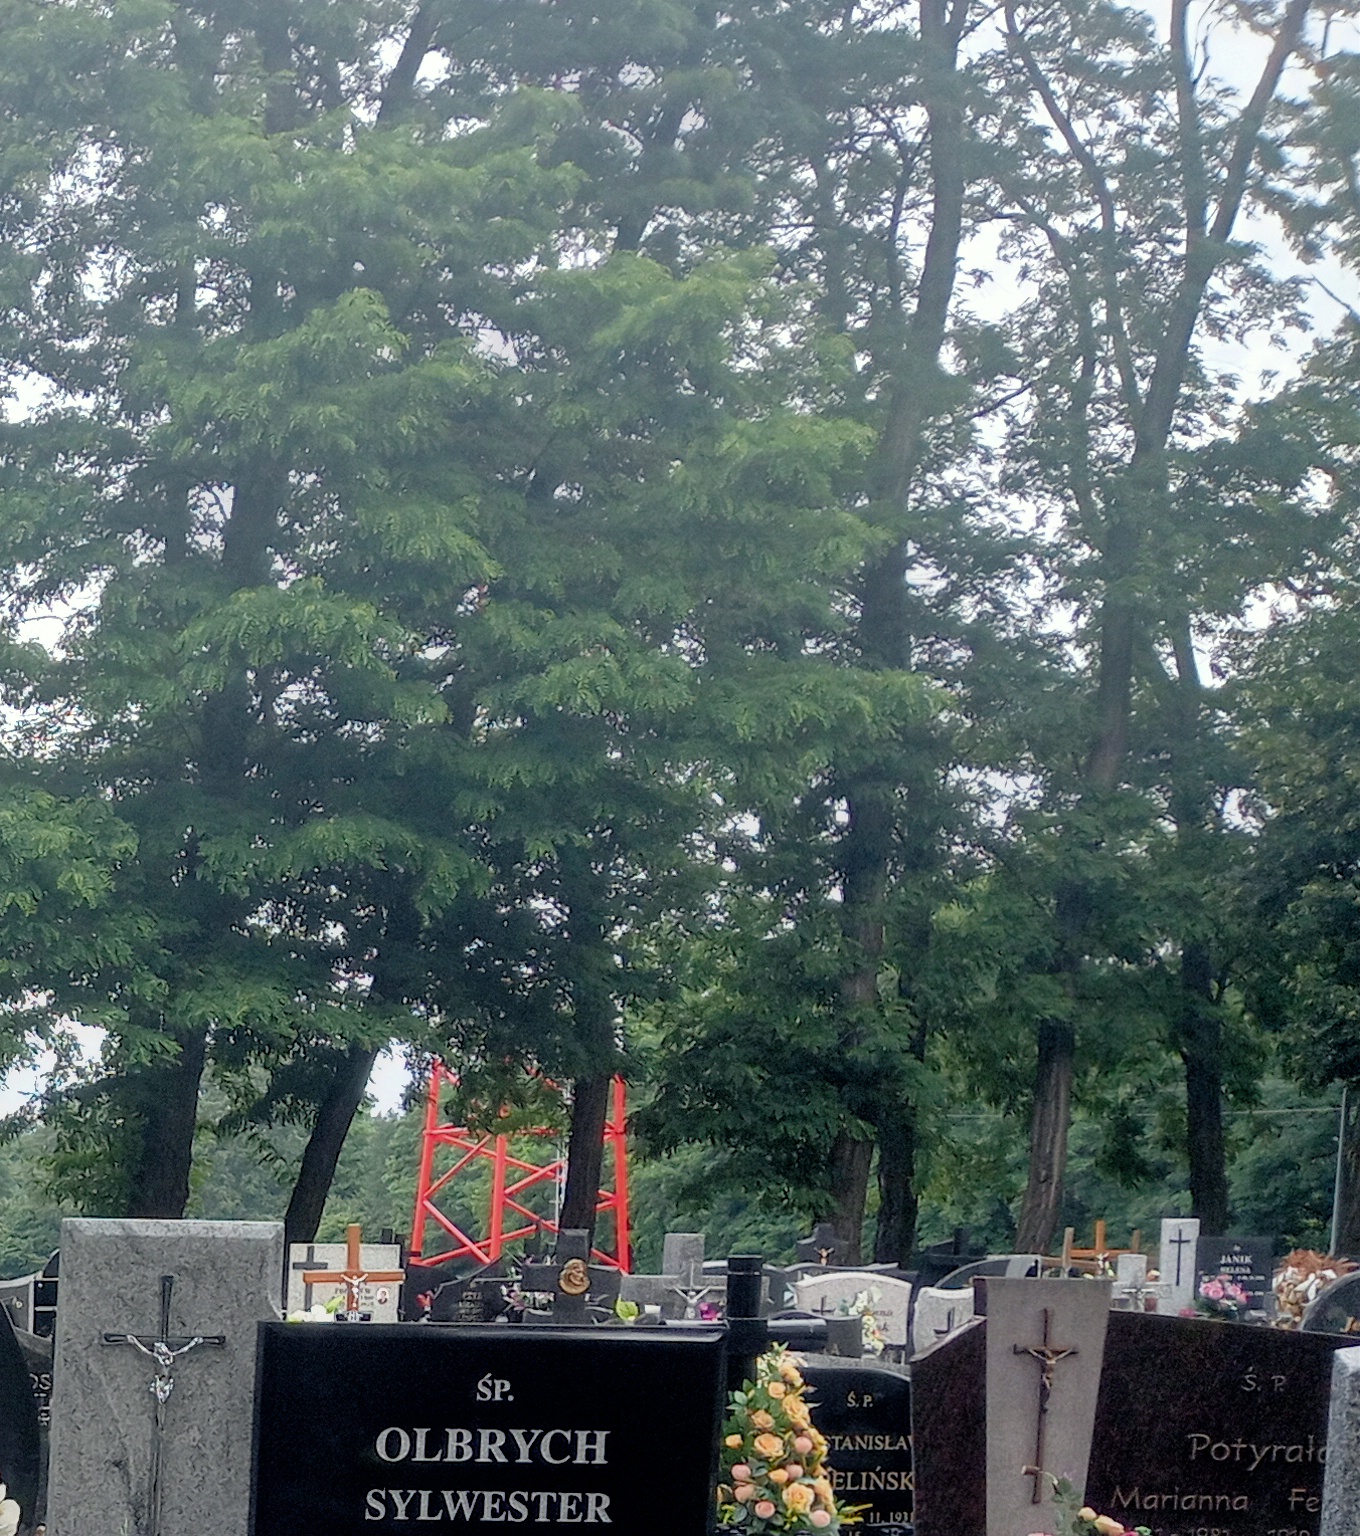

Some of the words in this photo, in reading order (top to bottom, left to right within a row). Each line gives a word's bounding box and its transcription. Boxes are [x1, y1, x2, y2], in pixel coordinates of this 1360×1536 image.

[476, 1373, 515, 1402] ŚP.
[376, 1427, 611, 1465] OLBRYCH
[829, 1466, 915, 1491] ELIŃSK
[365, 1487, 613, 1524] SYLWESTER
[1110, 1485, 1251, 1511] Marianna
